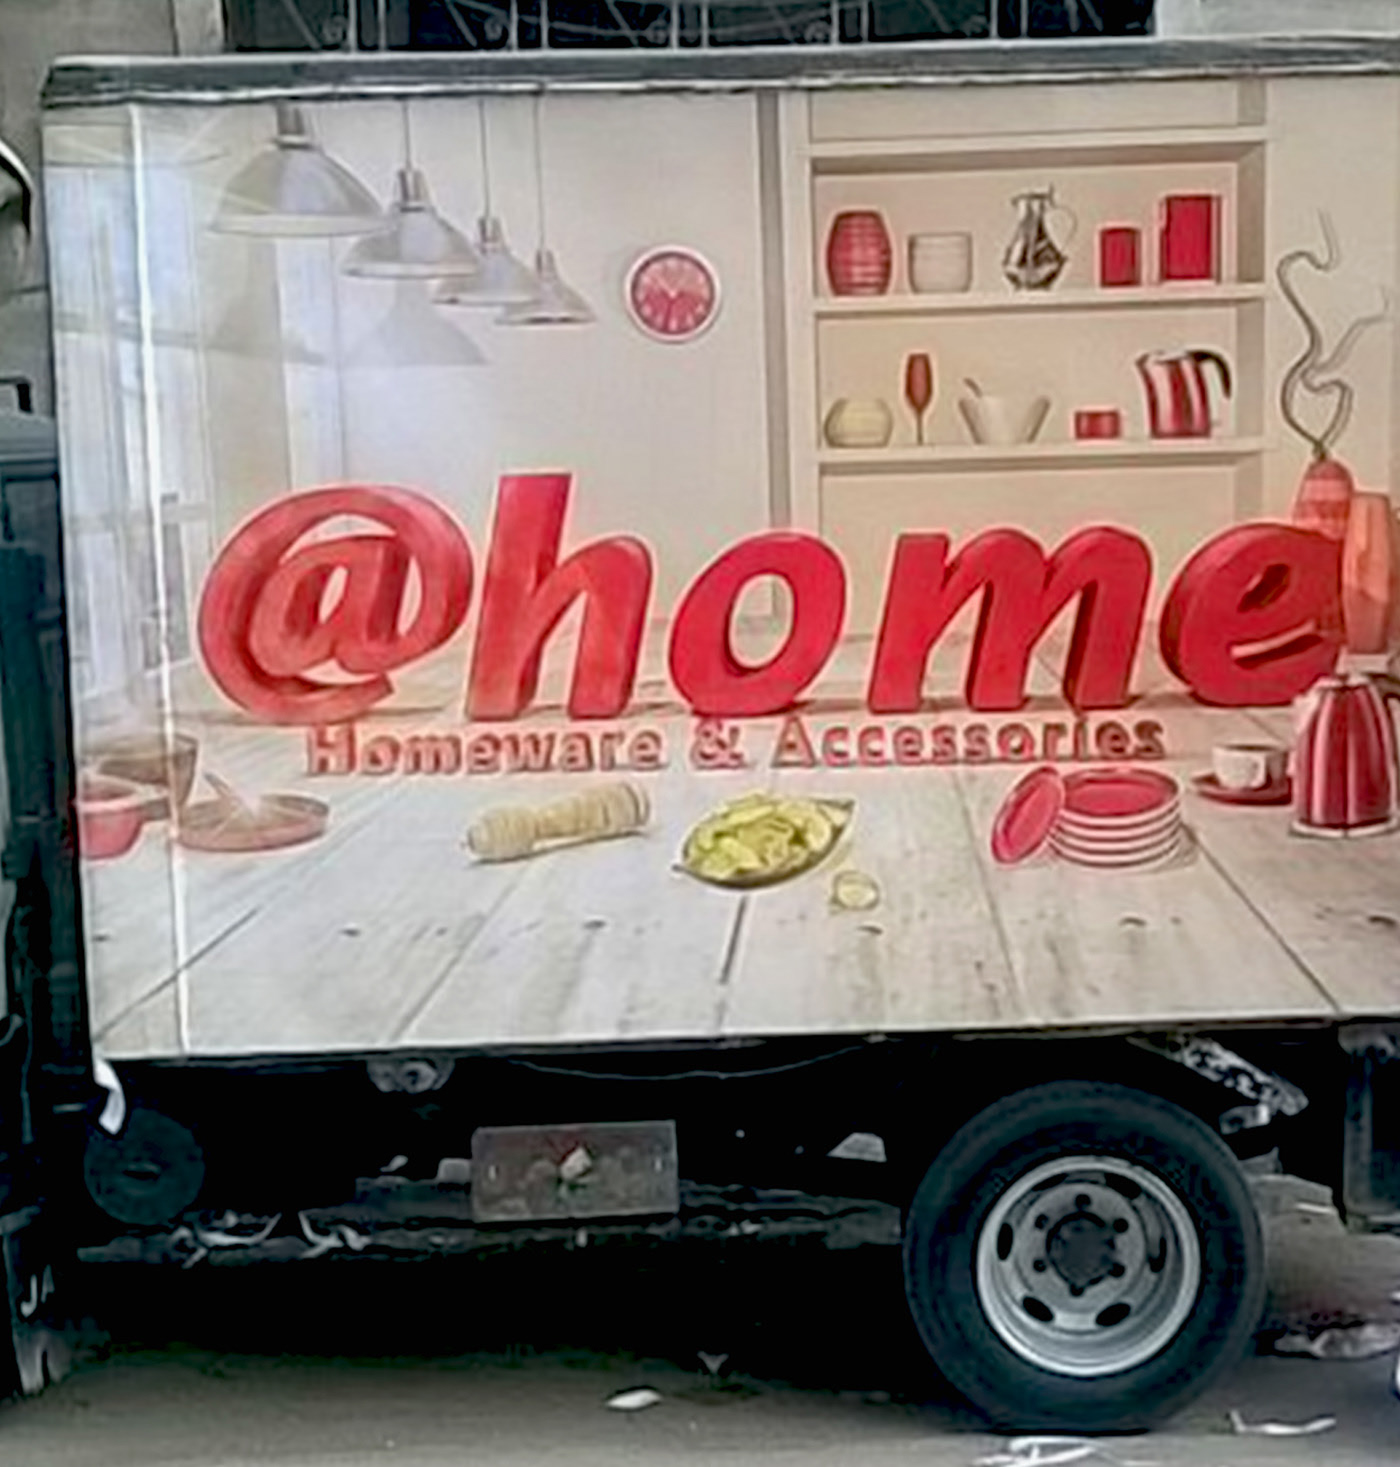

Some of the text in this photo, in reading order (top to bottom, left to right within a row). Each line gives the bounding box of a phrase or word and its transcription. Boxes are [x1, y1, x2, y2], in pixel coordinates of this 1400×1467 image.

[196, 472, 1342, 724] @home
[306, 712, 1167, 776] Homeware & Accessories
